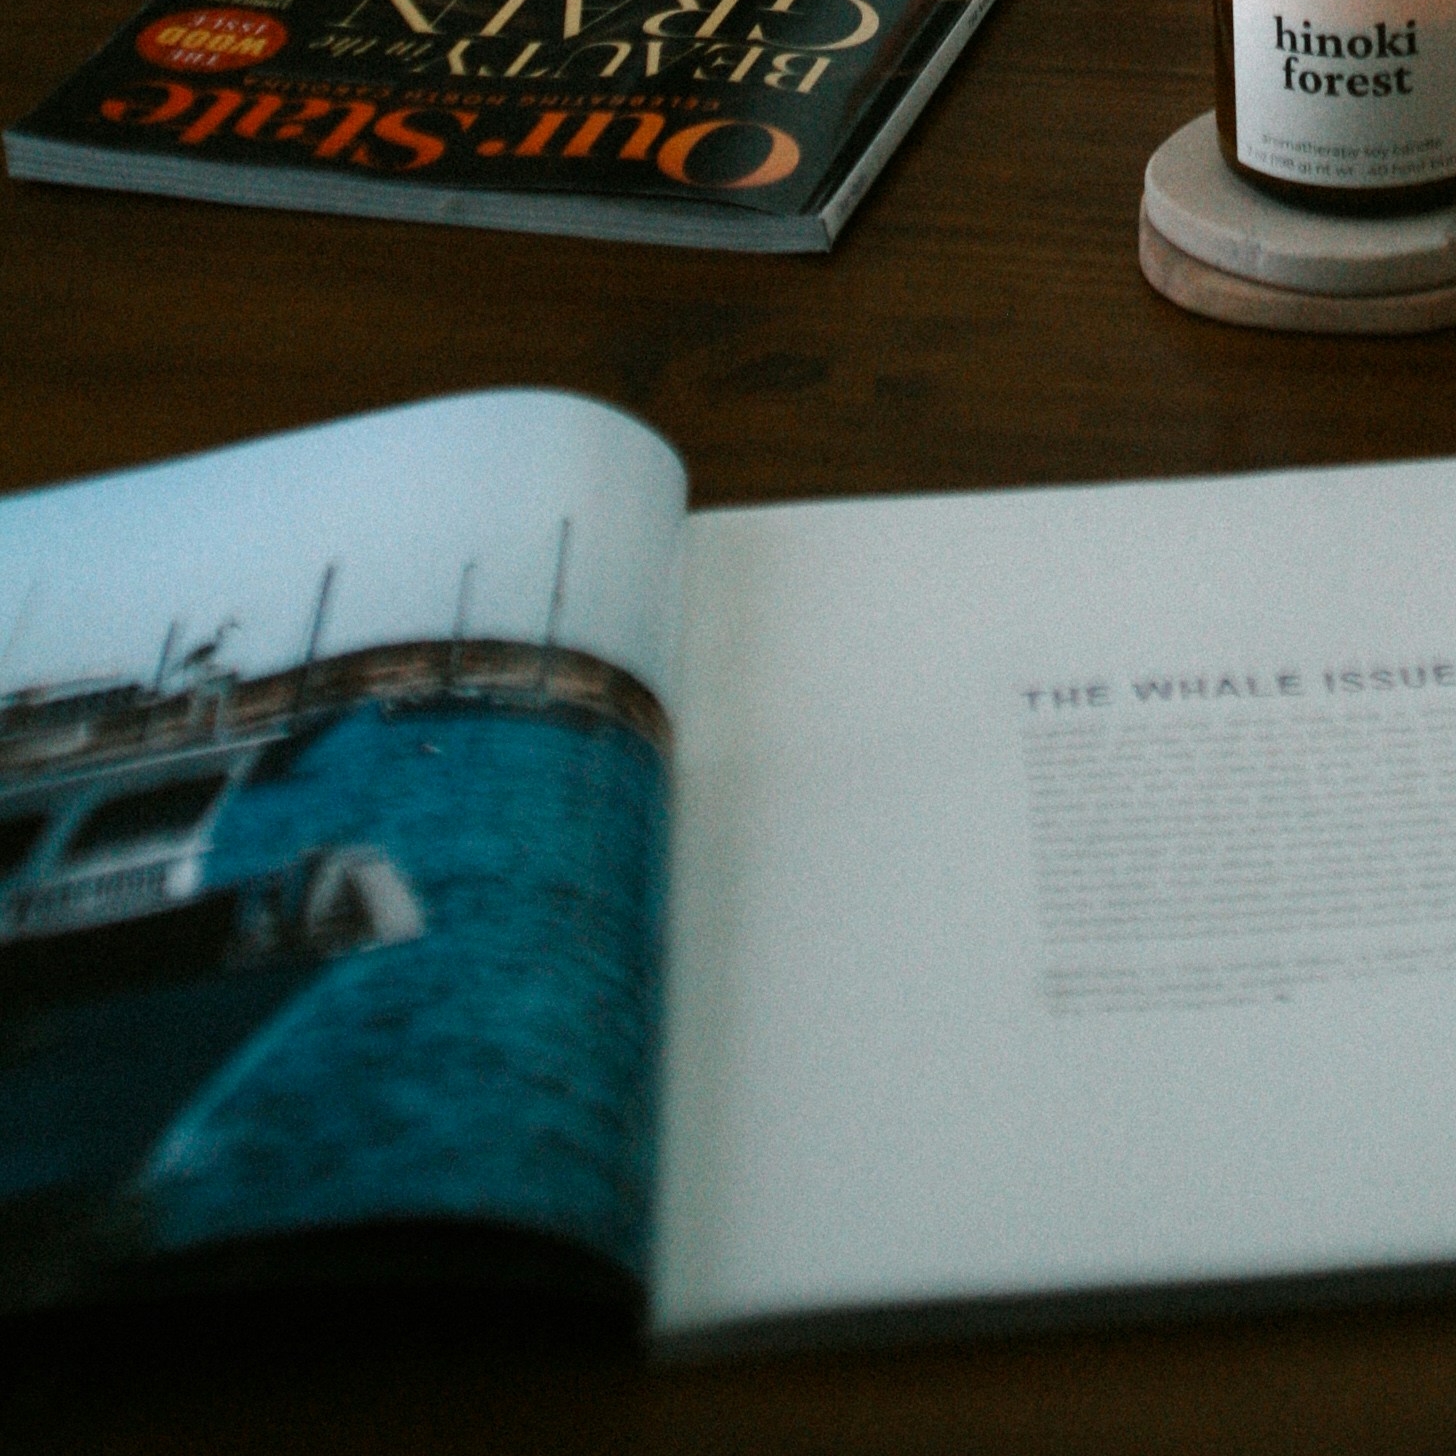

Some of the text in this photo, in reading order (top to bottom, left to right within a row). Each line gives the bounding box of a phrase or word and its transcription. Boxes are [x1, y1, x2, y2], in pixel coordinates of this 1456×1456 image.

[156, 25, 267, 57] WOOD
[1273, 15, 1419, 59] hinoki
[411, 39, 832, 94] BEAUTY
[1282, 55, 1414, 98] forest
[101, 80, 478, 170] State
[476, 109, 801, 189] Our
[1018, 682, 1116, 712] THE
[1131, 671, 1302, 704] WHALE
